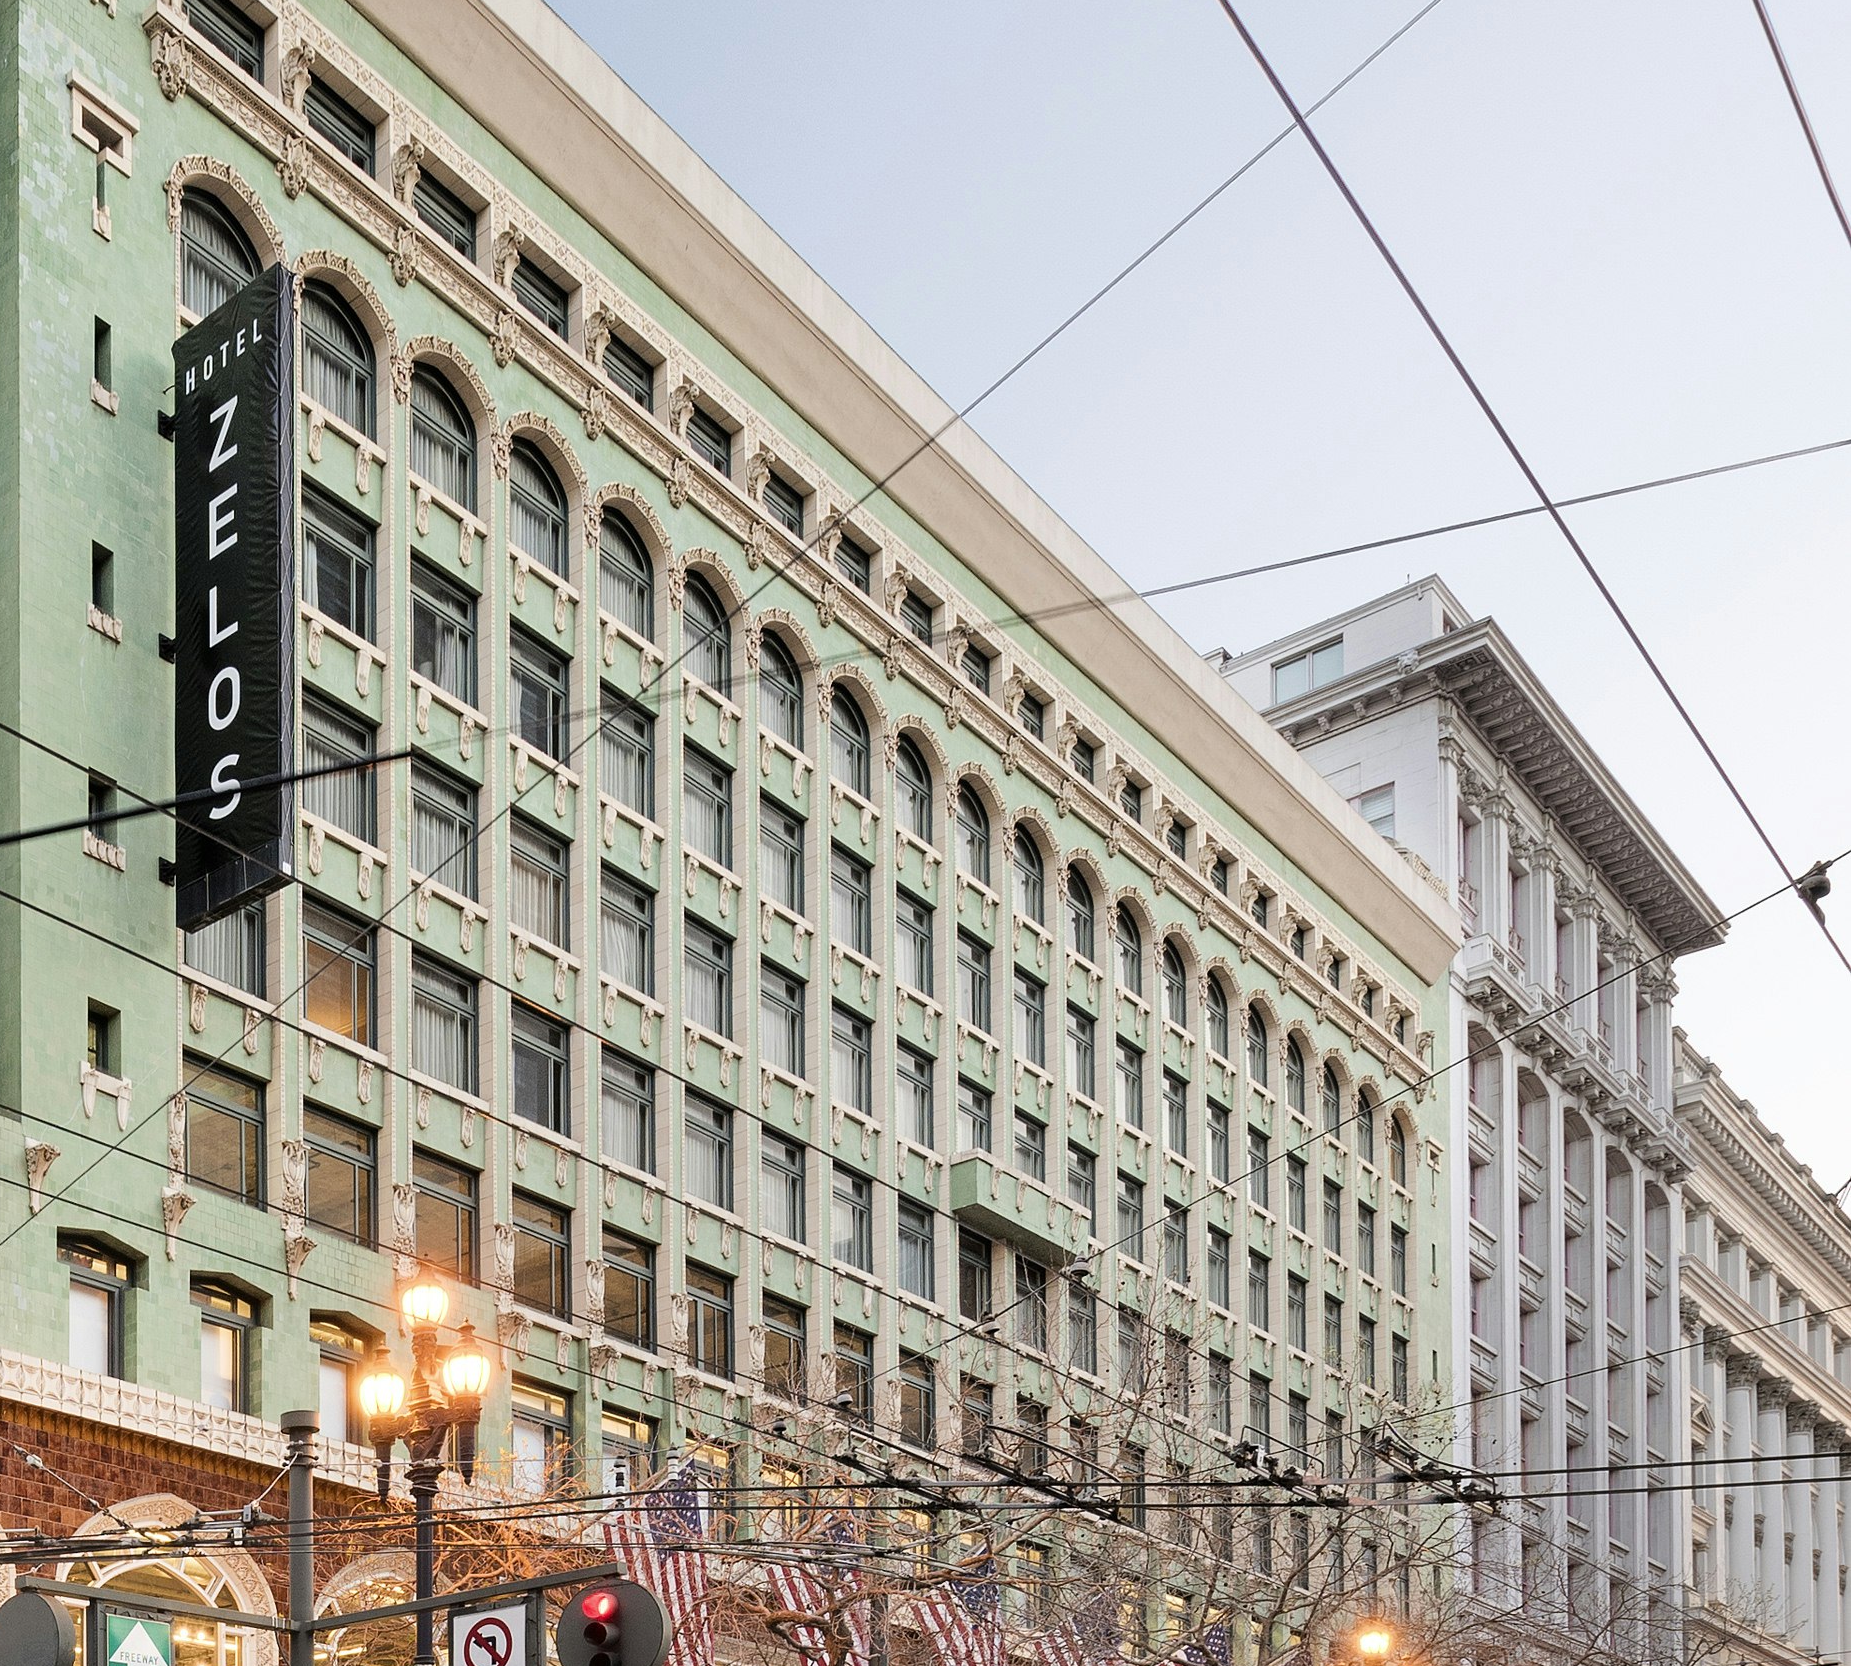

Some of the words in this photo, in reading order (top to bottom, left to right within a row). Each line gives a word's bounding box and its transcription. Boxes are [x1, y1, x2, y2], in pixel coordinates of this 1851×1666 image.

[185, 317, 264, 396] HOTEL
[208, 395, 242, 820] ZELOS
[119, 1651, 159, 1666] FREEWAY
